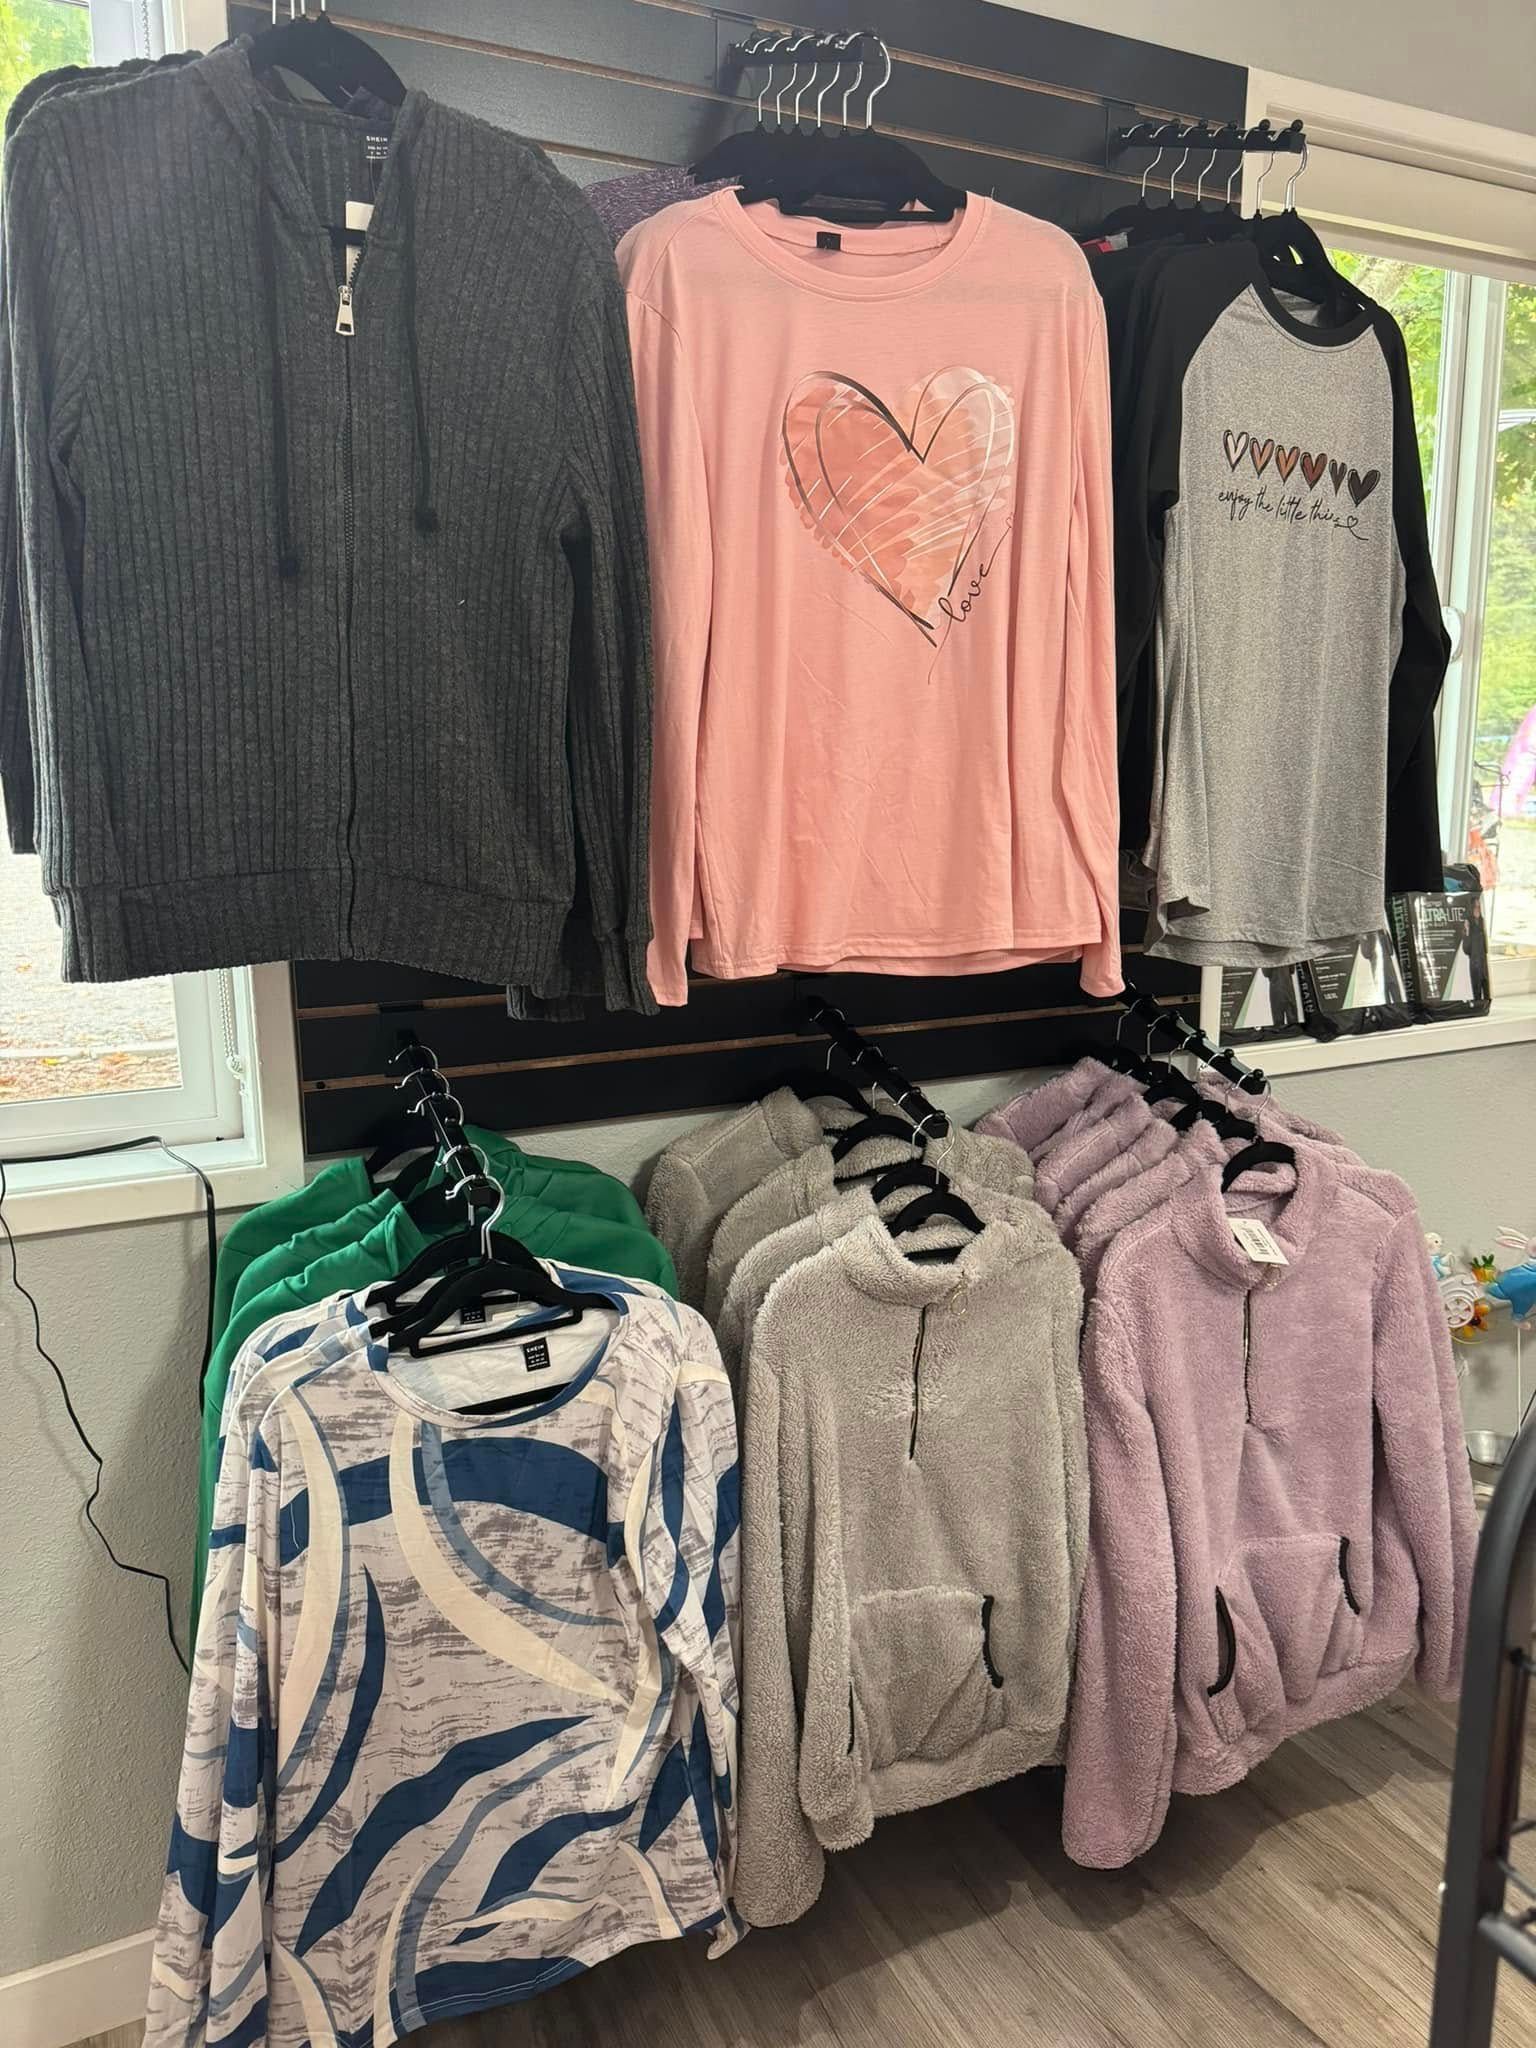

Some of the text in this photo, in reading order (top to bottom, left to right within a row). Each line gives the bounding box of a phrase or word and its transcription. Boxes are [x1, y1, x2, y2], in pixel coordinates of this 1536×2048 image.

[1218, 488, 1253, 521] enjoy
[1254, 484, 1275, 511] the
[1275, 494, 1307, 524] little
[1301, 982, 1315, 1013] RAIN
